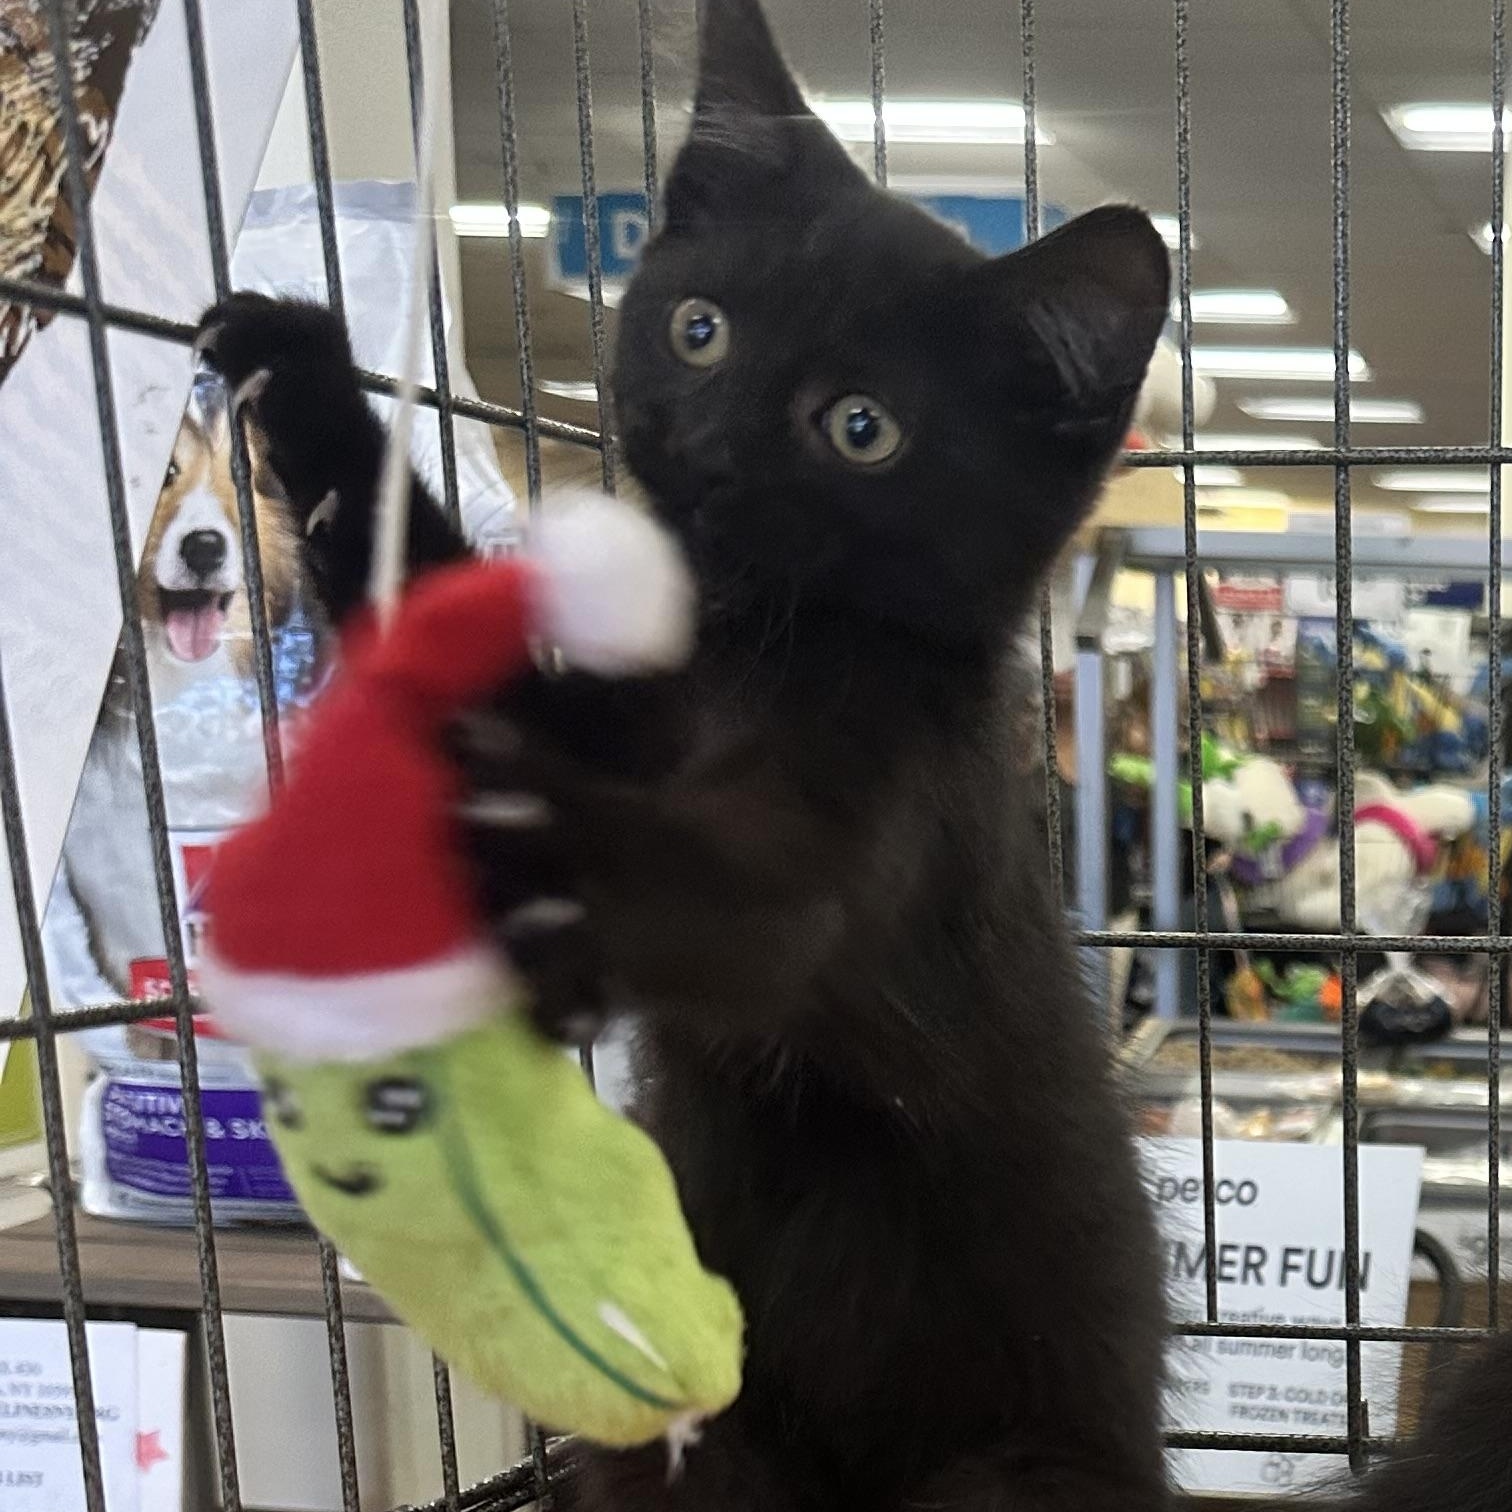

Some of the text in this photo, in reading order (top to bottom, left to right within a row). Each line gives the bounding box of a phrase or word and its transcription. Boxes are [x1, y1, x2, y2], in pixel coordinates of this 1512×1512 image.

[207, 1116, 226, 1139] &
[1157, 1177, 1259, 1208] peco
[1217, 1341, 1296, 1360] summer
[1301, 1342, 1346, 1369] long
[1229, 1382, 1265, 1400] STEP
